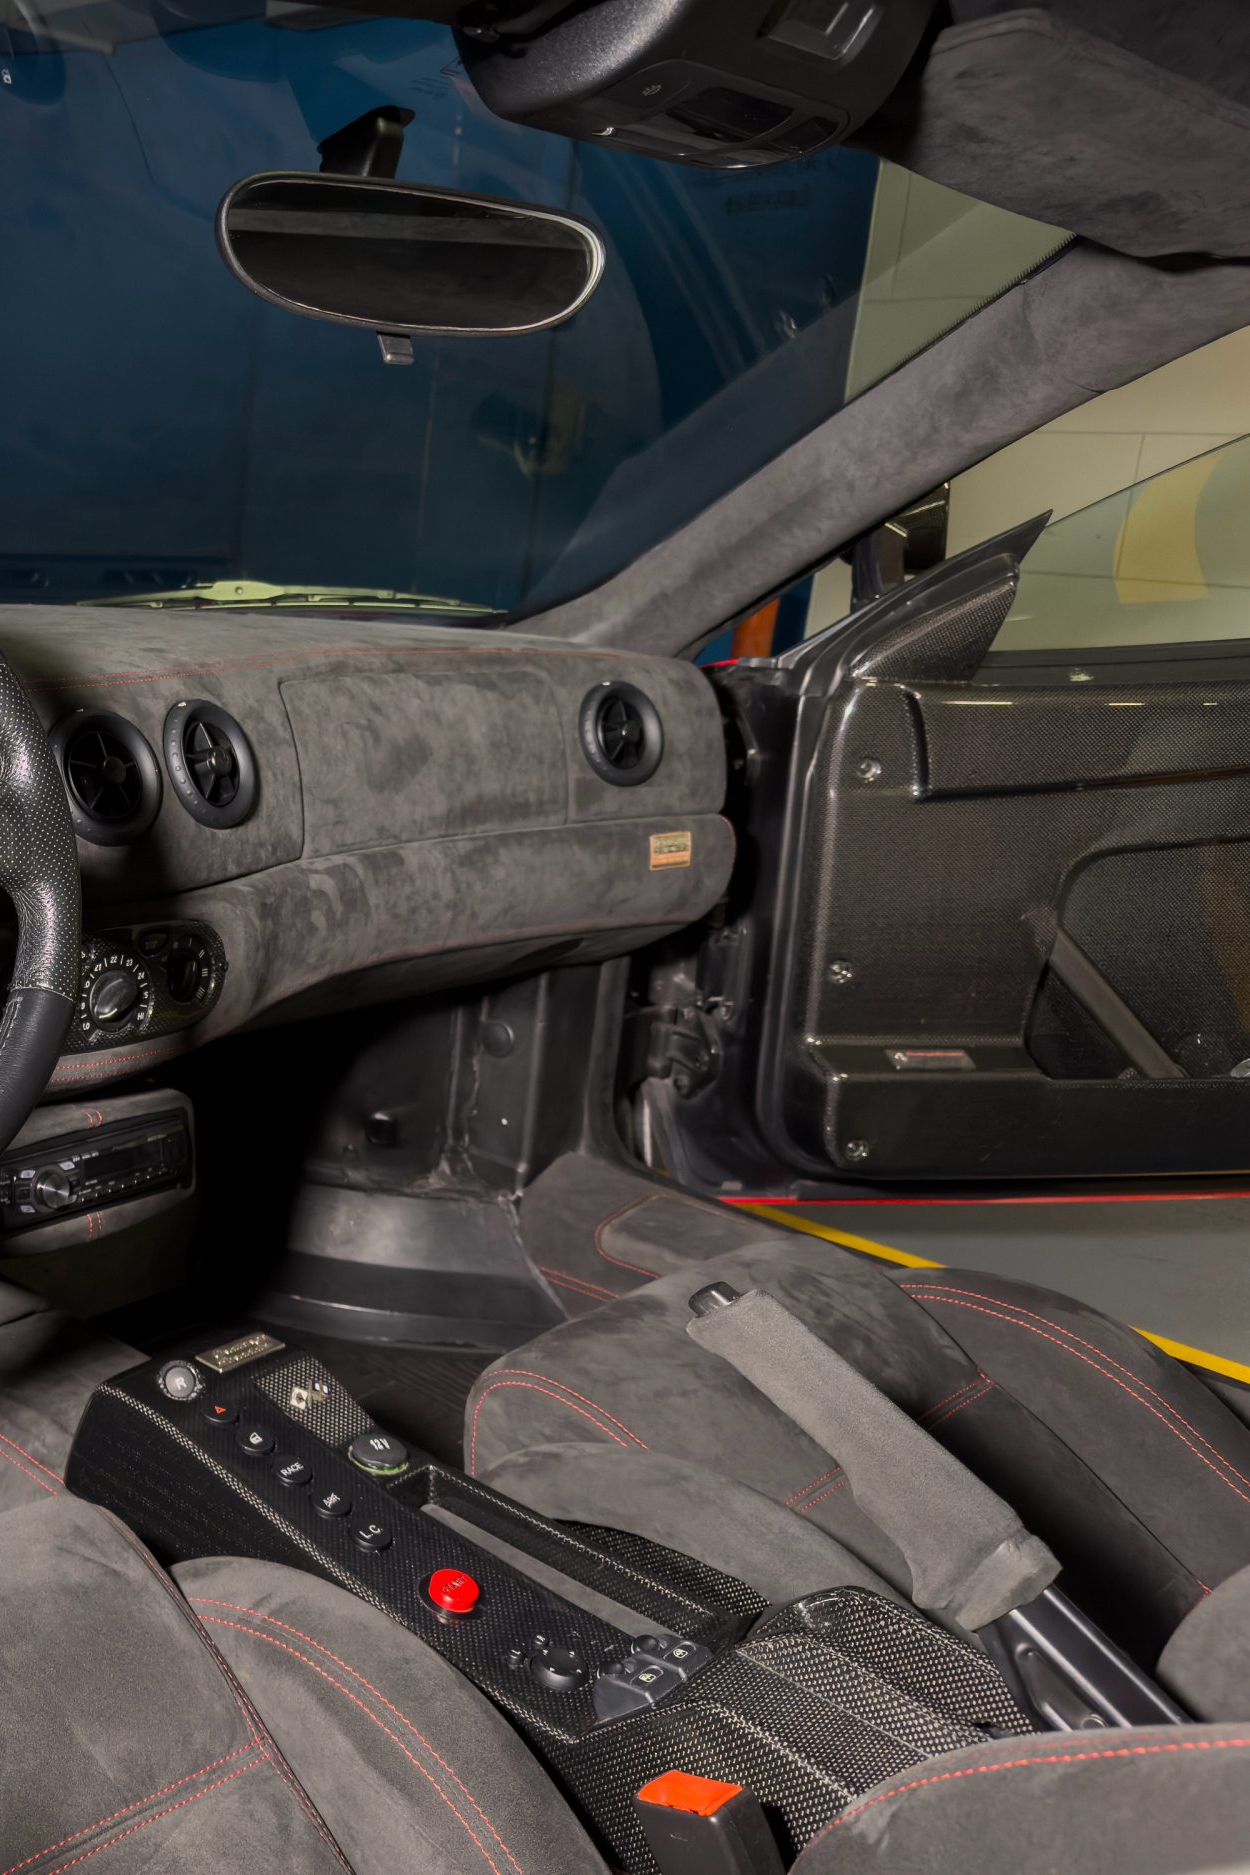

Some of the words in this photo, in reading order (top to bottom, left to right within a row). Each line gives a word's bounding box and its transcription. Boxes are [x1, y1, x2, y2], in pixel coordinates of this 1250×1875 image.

[110, 955, 118, 964] 22
[125, 958, 134, 967] 23
[94, 963, 102, 972] 21
[137, 971, 145, 980] 24
[137, 1012, 145, 1021] HI
[175, 1377, 187, 1390] R
[369, 1437, 392, 1450] 12V
[280, 1461, 304, 1477] RACE
